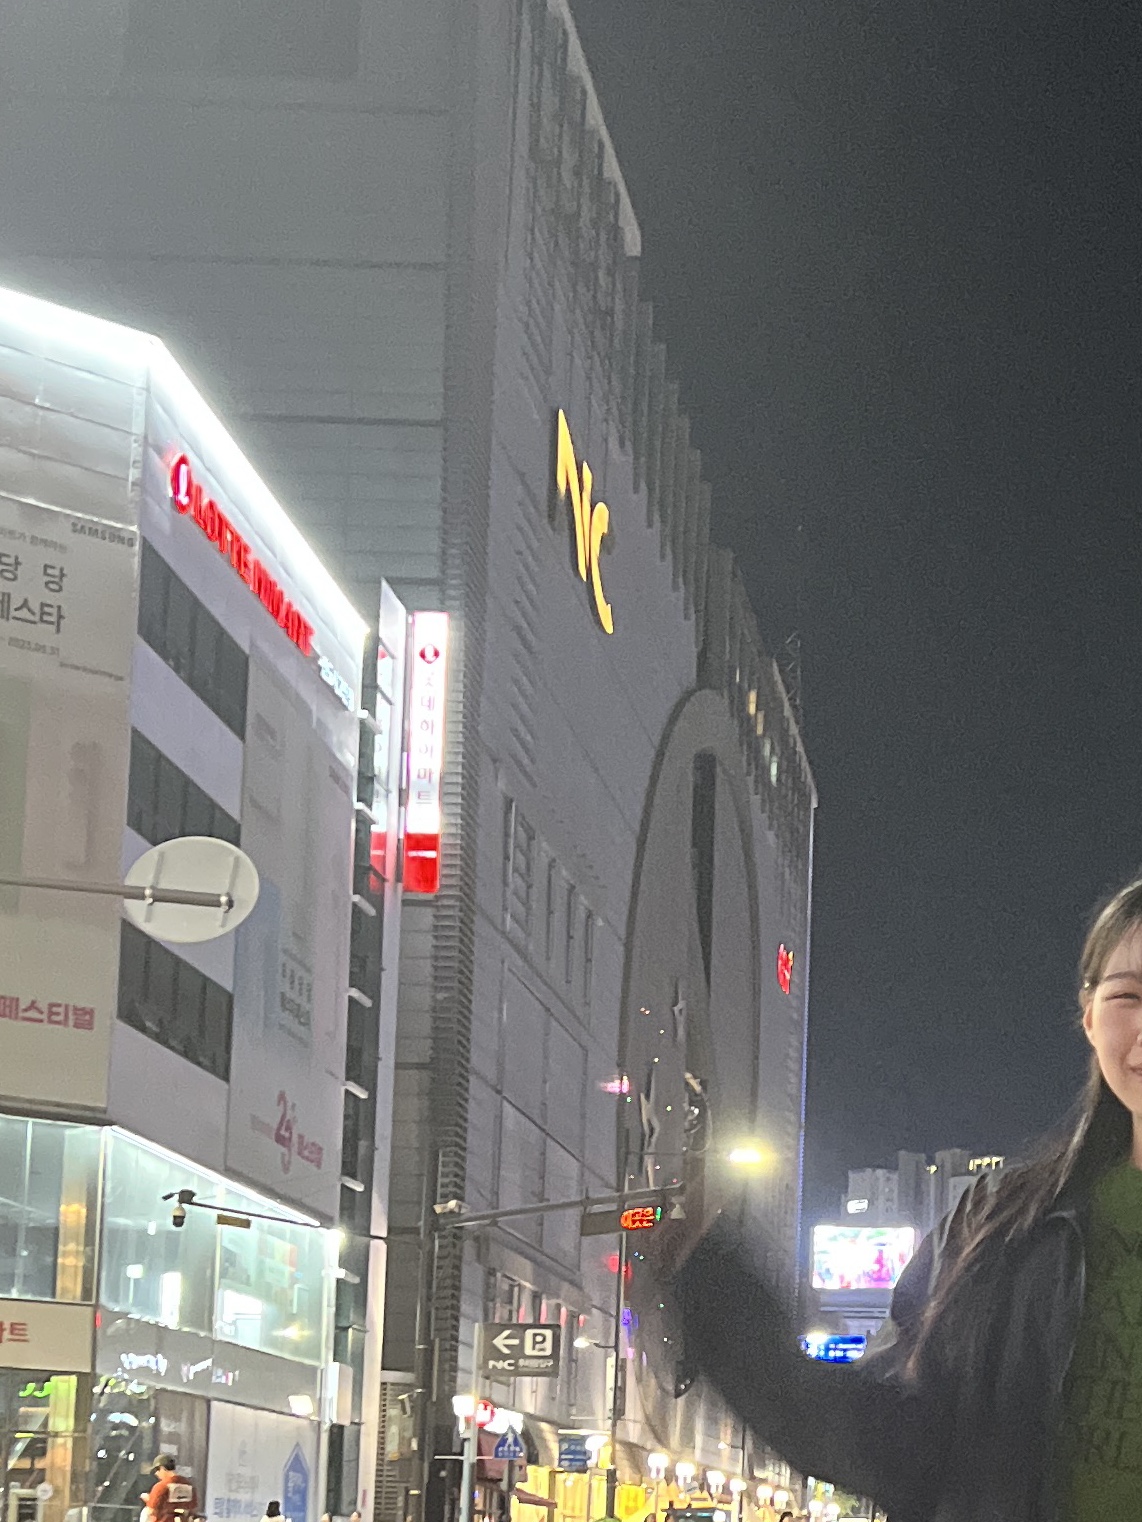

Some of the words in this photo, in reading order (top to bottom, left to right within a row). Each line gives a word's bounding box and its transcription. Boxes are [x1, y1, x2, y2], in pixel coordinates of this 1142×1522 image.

[71, 520, 135, 548] SAMSUNG
[190, 484, 252, 585] LOTTE
[43, 562, 67, 594] 당
[488, 1359, 515, 1370] NC
